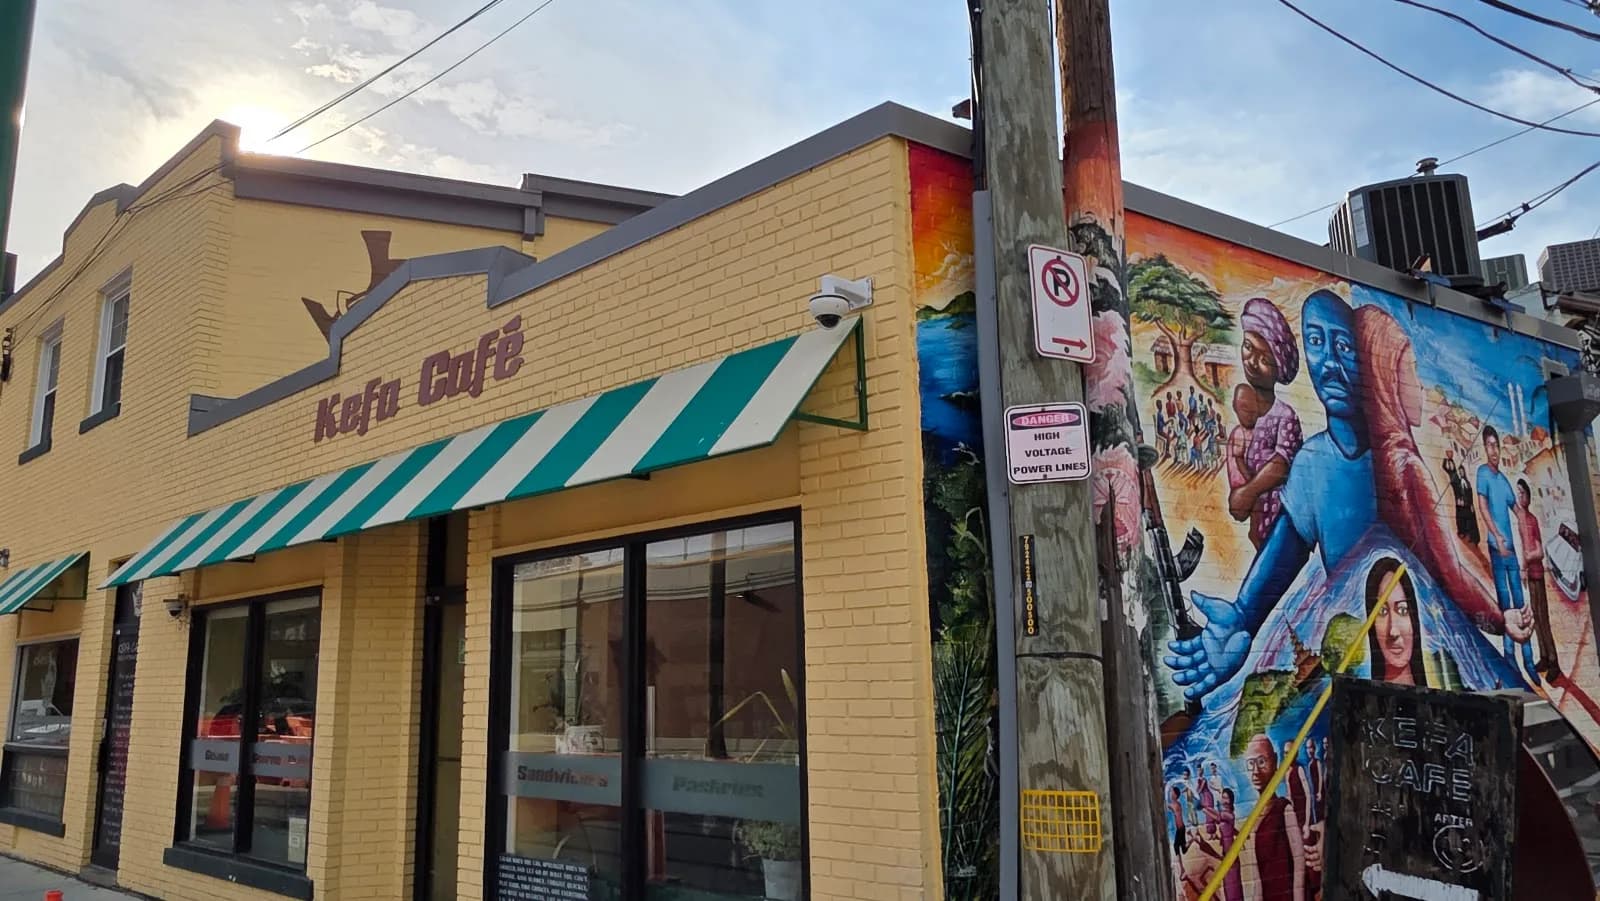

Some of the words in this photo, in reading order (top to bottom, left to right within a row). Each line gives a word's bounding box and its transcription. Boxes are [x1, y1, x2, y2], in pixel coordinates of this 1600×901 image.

[1052, 267, 1070, 297] P
[313, 376, 401, 443] Kefa
[417, 314, 525, 407] Café
[1021, 413, 1069, 425] DANGER
[1034, 431, 1060, 441] HIGH
[1024, 447, 1072, 458] VOLTAGE
[1013, 464, 1053, 475] POWER
[1055, 462, 1087, 472] LINES
[517, 765, 608, 787] Sandwics
[1365, 759, 1473, 802] CAFE
[1434, 813, 1473, 827] AFTER
